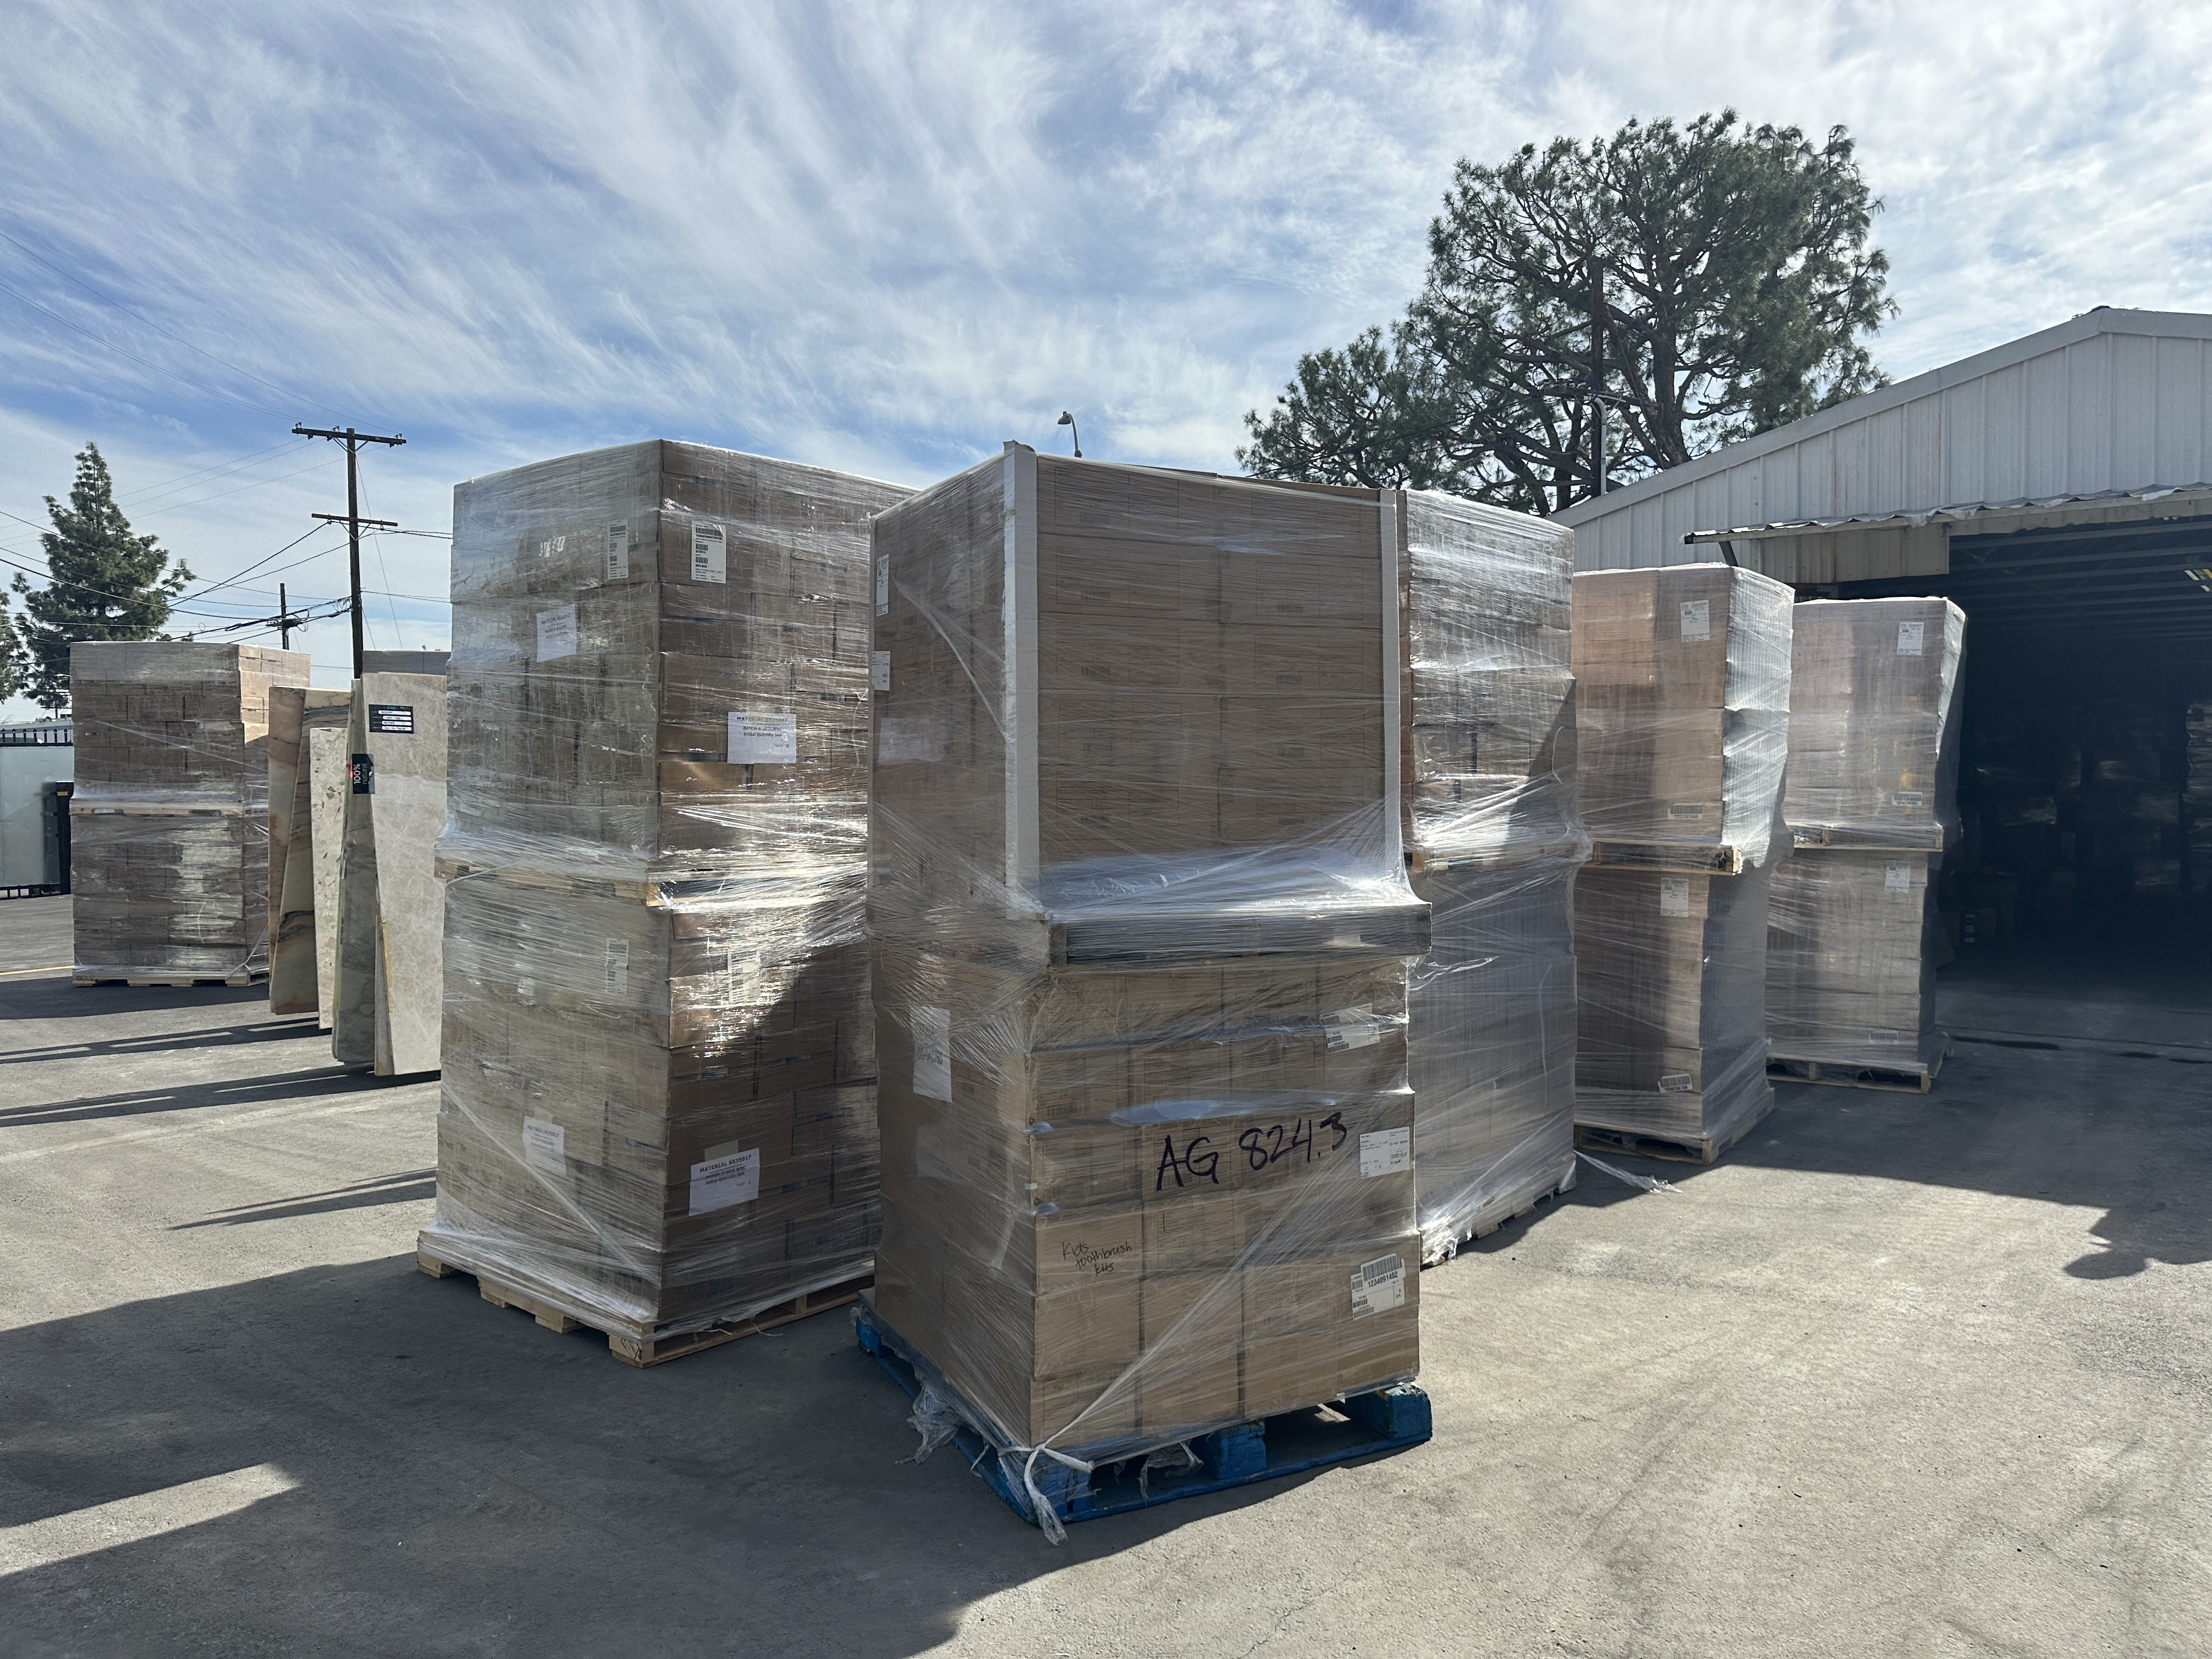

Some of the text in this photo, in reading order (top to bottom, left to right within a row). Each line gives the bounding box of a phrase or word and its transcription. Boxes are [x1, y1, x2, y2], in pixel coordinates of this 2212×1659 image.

[353, 763, 361, 785] 100%
[699, 1161, 727, 1173] MATERIAL
[1156, 1135, 1220, 1191] AG
[1062, 1242, 1089, 1261] Kids
[1075, 1240, 1132, 1270] toothbrush
[1368, 1271, 1398, 1288] 1234091402
